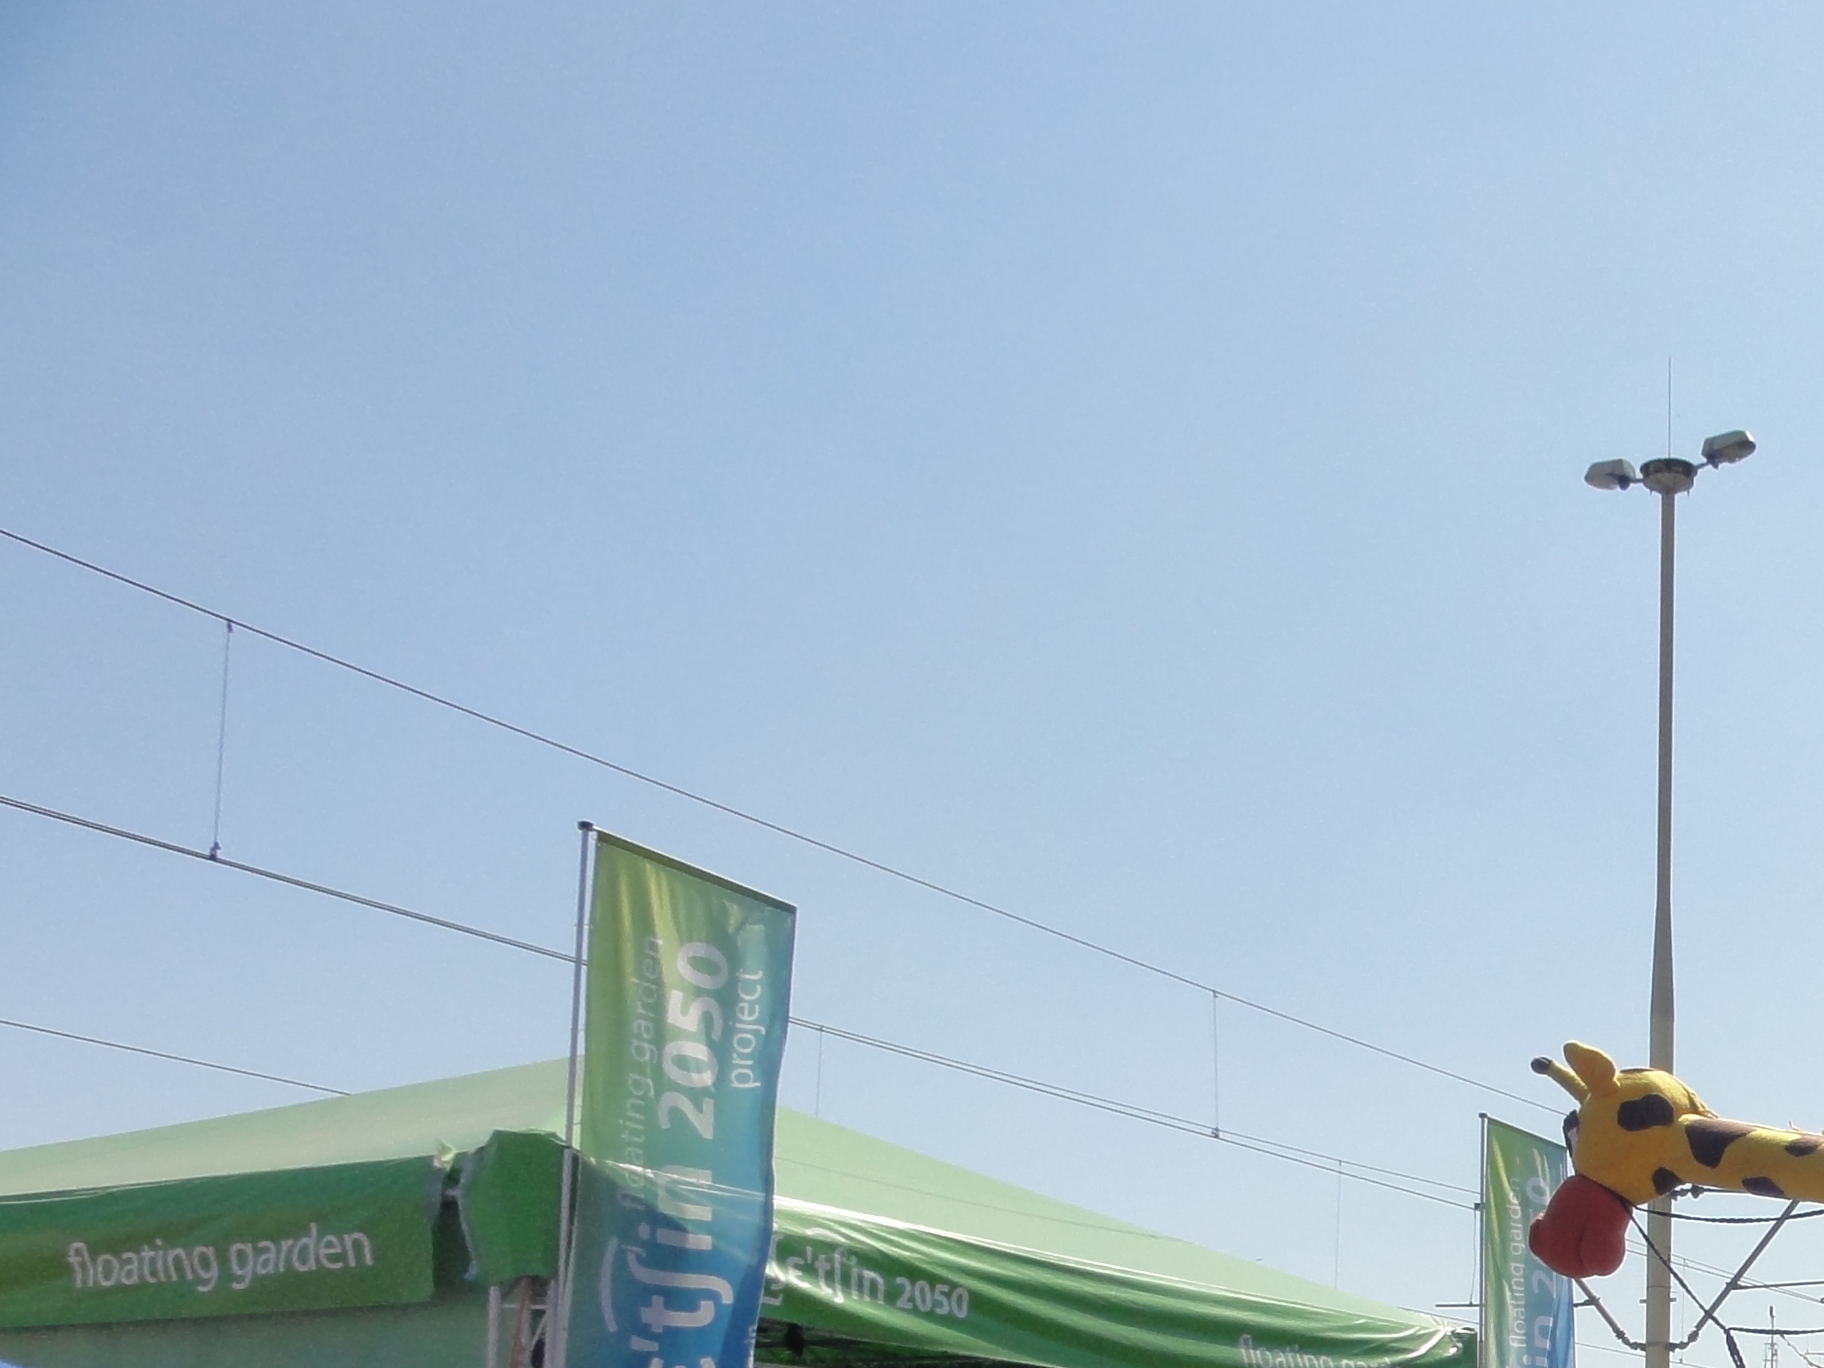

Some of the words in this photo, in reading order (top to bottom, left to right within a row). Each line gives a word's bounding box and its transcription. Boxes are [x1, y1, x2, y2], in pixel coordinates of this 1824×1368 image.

[630, 936, 664, 1064] garden
[658, 942, 729, 1139] 2050
[729, 968, 767, 1089] project
[66, 1238, 218, 1292] floating
[228, 1222, 374, 1290] garden
[1508, 1177, 1526, 1254] garden
[1525, 1176, 1557, 1298] 20
[895, 1276, 969, 1318] 2050
[1510, 1259, 1528, 1349] floating
